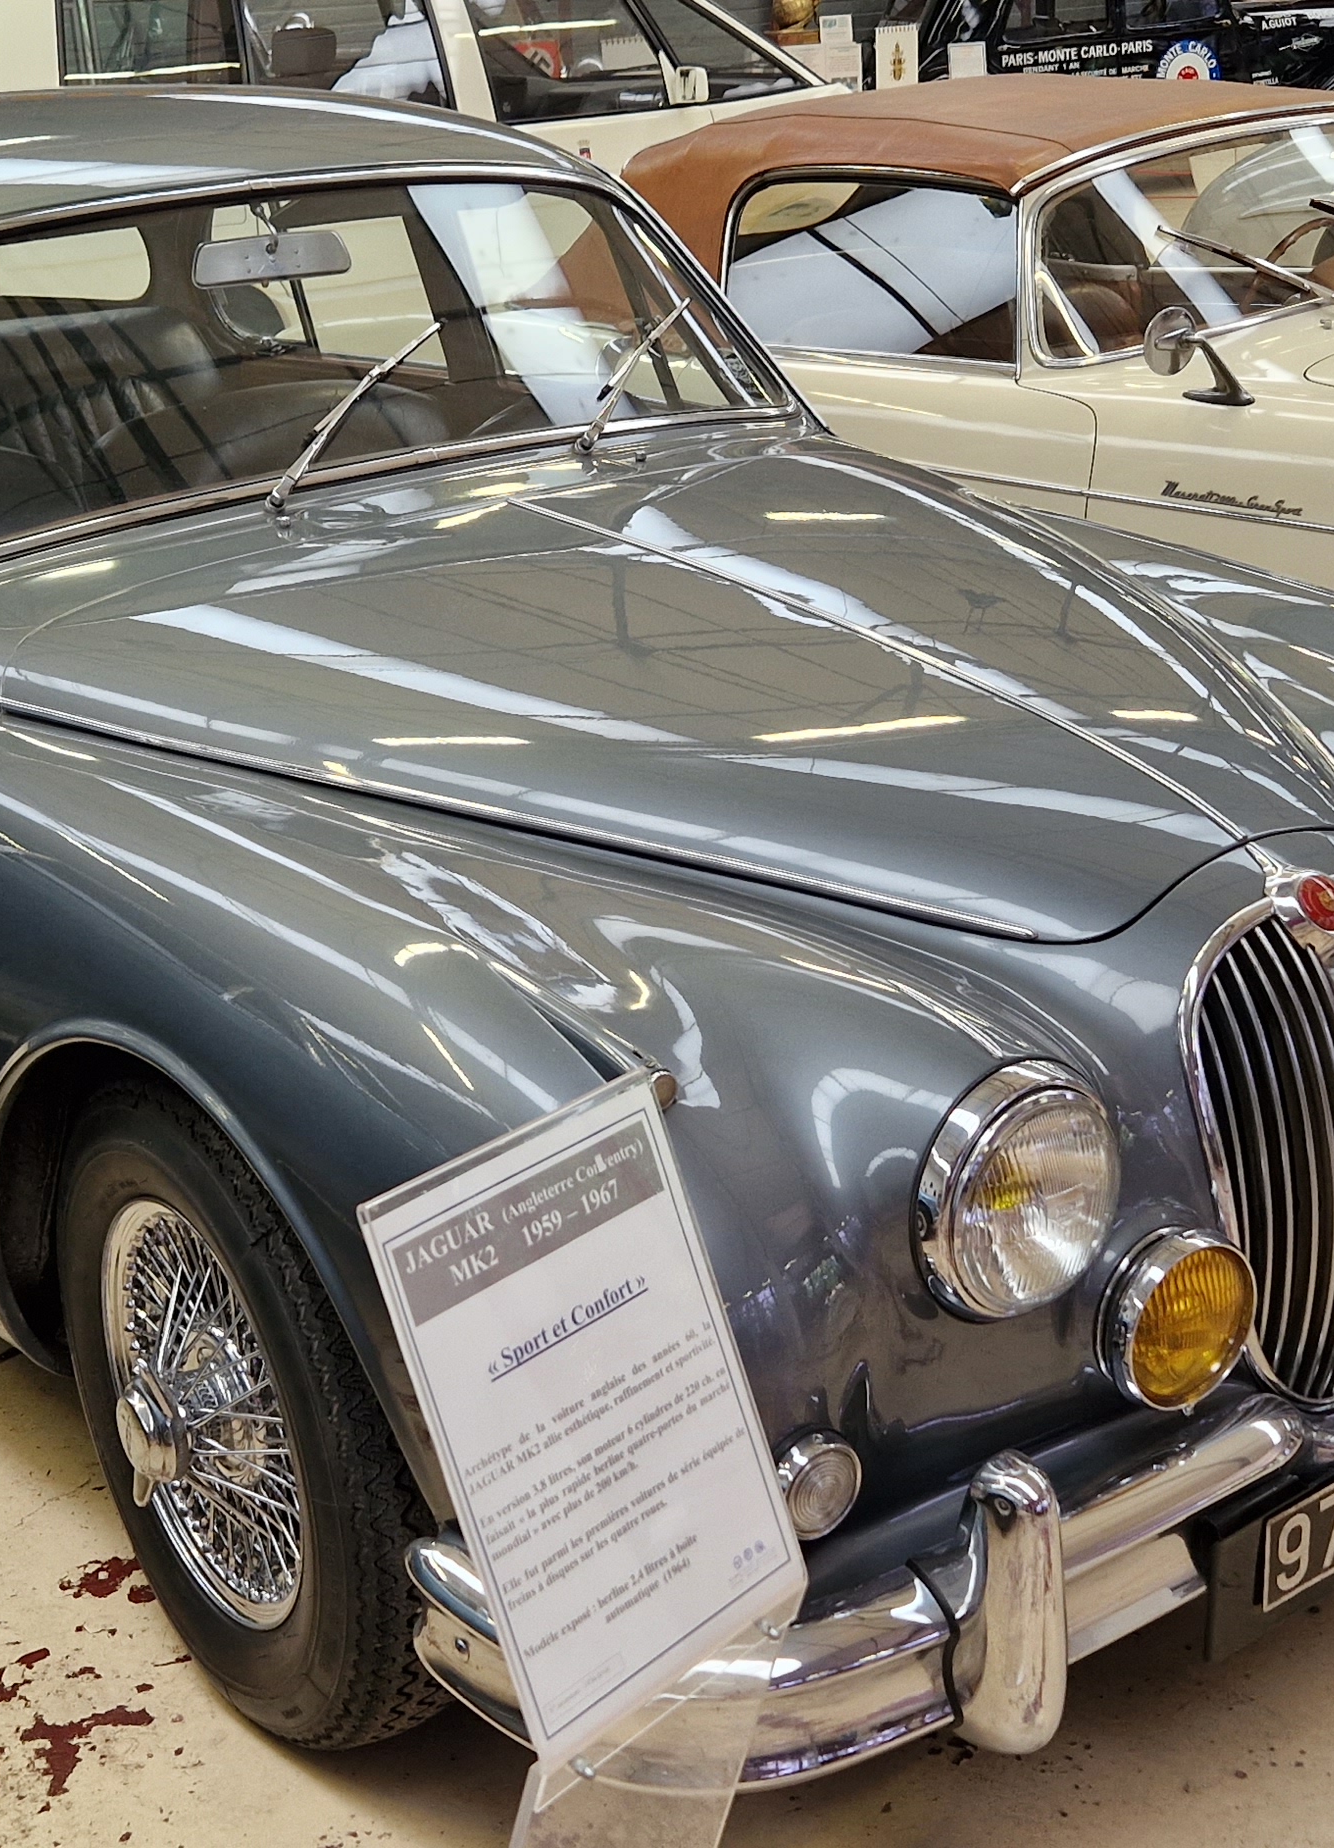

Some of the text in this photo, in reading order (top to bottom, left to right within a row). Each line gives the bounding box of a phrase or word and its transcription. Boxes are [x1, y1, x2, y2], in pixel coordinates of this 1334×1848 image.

[1156, 42, 1183, 78] MONTE
[1188, 40, 1217, 68] CARLO
[406, 1212, 494, 1273] JAGUAR
[502, 1178, 573, 1224] (Angleterre
[449, 1245, 498, 1286] MK2
[522, 1210, 562, 1246] 1959
[581, 1179, 617, 1214] 1967
[501, 1330, 548, 1367] Sport
[553, 1318, 567, 1337] et
[571, 1280, 633, 1325] Confort
[465, 1444, 512, 1476] Archétype
[519, 1433, 530, 1444] de
[535, 1424, 545, 1433] la
[552, 1400, 584, 1423] voiture
[591, 1374, 625, 1400] anglaise
[632, 1362, 646, 1375] des
[652, 1342, 680, 1363] années
[702, 1322, 711, 1331] la
[470, 1339, 712, 1495] JAGUAR MK2 allie esthétique, raffinement et sportivité.
[480, 1516, 494, 1528] En
[497, 1492, 531, 1517] version
[533, 1480, 547, 1495] 3,8
[548, 1466, 576, 1485] litres,
[577, 1453, 592, 1467] son
[595, 1432, 625, 1456] moteur
[626, 1423, 634, 1435] 6
[635, 1402, 673, 1430] cylindres
[674, 1394, 683, 1404] de
[685, 1381, 700, 1397] 220
[716, 1368, 725, 1378] en
[486, 1521, 515, 1545] faisait
[526, 1509, 536, 1519] la
[539, 1495, 559, 1514] plus
[562, 1473, 591, 1496] rapide
[593, 1451, 624, 1476] berline
[627, 1413, 683, 1455] quatre-portes
[686, 1404, 697, 1415] du
[700, 1382, 729, 1406] marché
[492, 1529, 531, 1561] mondial
[541, 1512, 561, 1530] avec
[563, 1499, 582, 1518] plus
[584, 1490, 594, 1501] de
[596, 1476, 611, 1493] 200
[613, 1462, 638, 1482] km/h.
[503, 1428, 745, 1594] Elle fut parmi les premières voitures de série équipée de
[508, 1501, 667, 1611] freins à disques sur les quatre roues.
[524, 1632, 558, 1657] Modèle
[561, 1608, 591, 1635] exposé
[597, 1583, 629, 1608] berline
[644, 1556, 668, 1575] litres
[668, 1546, 676, 1559] à
[676, 1535, 697, 1553] boîte
[606, 1580, 659, 1623] automatique
[664, 1558, 690, 1582] (1964)
